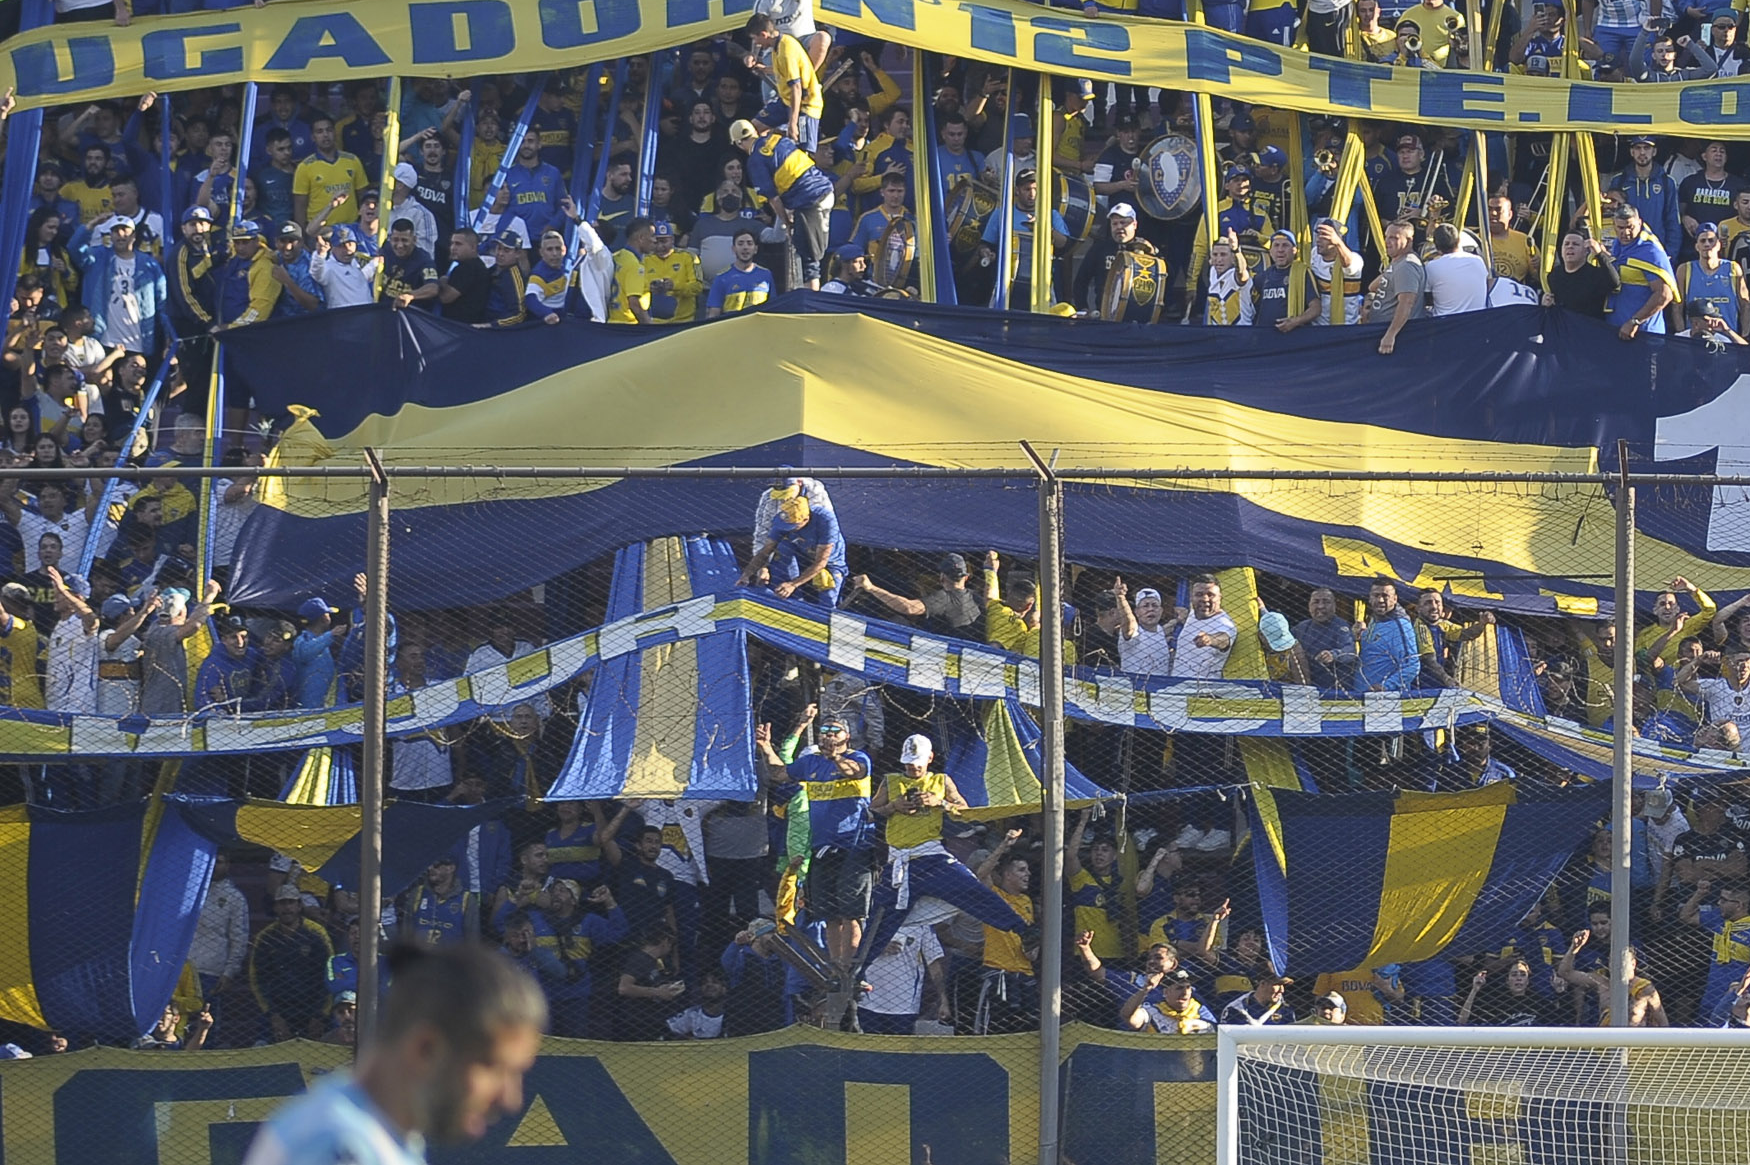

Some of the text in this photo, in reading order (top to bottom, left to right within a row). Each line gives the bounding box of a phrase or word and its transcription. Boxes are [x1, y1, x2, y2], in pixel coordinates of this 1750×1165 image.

[1154, 169, 1186, 181] CJ
[417, 186, 446, 203] BBVA
[517, 192, 547, 204] BBVA
[427, 930, 441, 944] 12
[1342, 981, 1373, 992] BBVA
